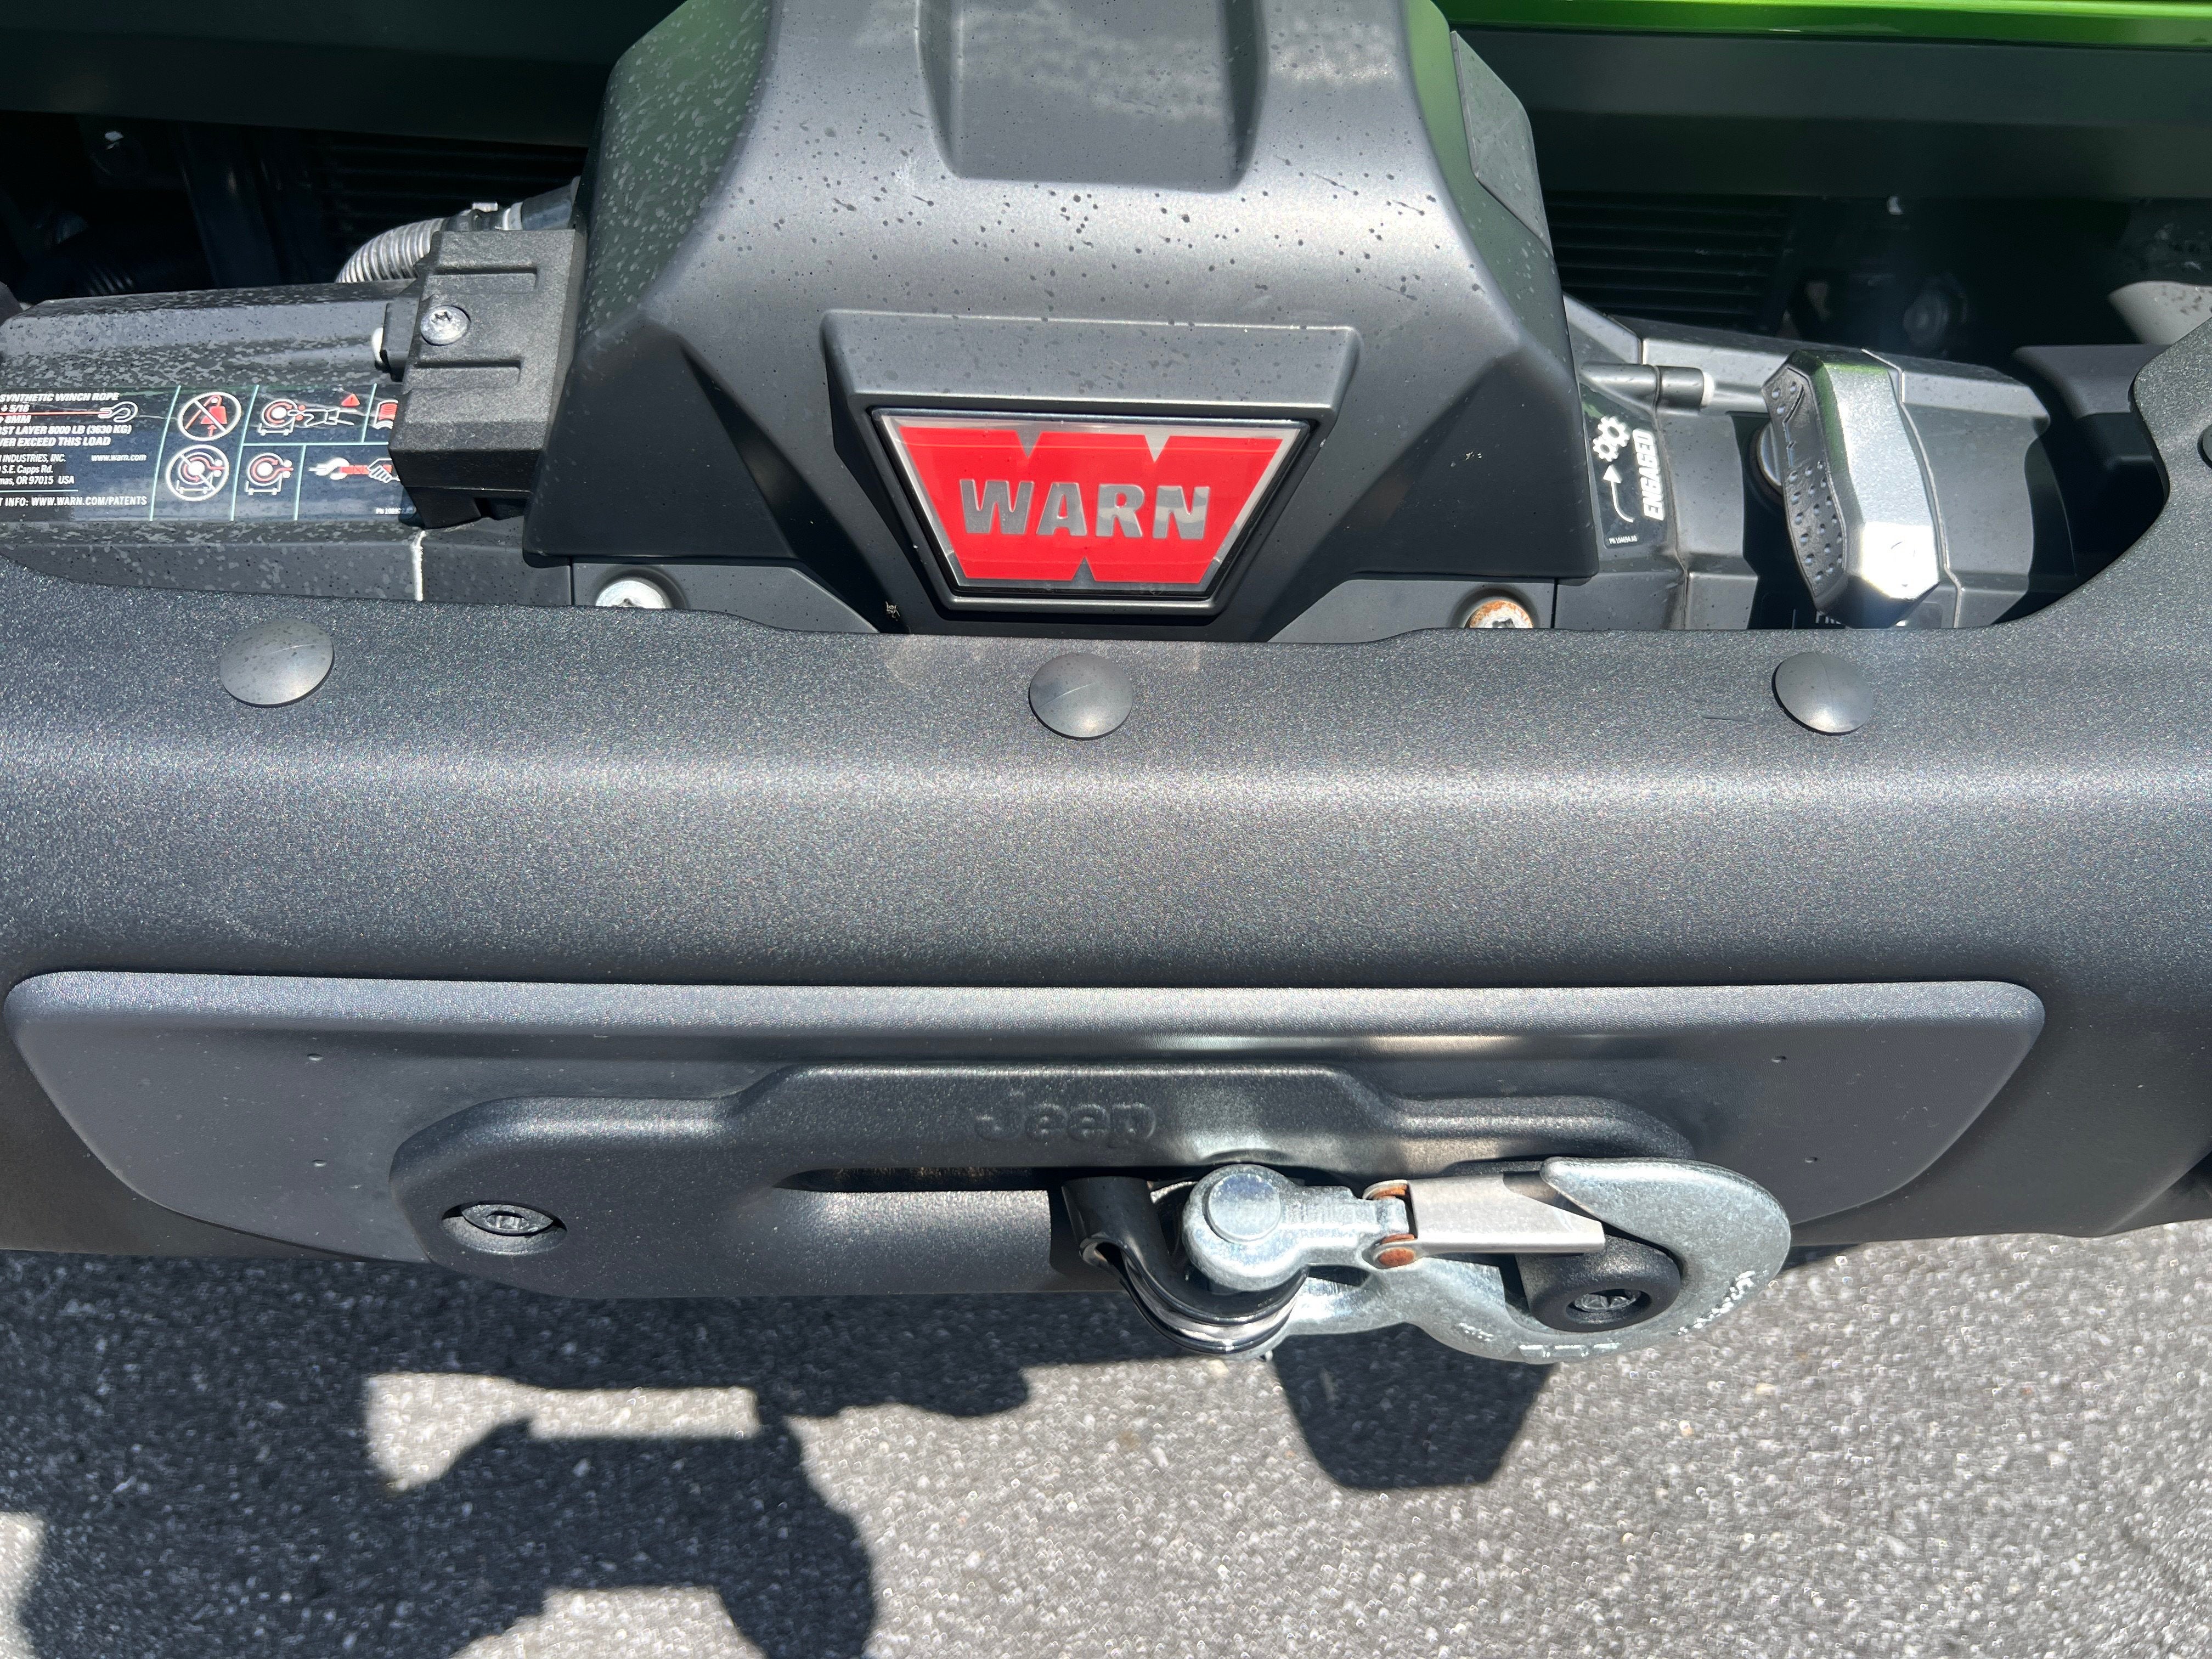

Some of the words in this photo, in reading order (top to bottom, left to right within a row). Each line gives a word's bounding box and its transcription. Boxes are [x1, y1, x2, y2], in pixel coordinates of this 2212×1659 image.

[0, 393, 54, 402] SYNTHETIC
[55, 393, 92, 402] WINCH
[92, 392, 120, 401] ROPE
[9, 404, 30, 413] 5/16
[4, 415, 32, 424] 8MM
[15, 425, 48, 435] LAYER
[48, 425, 71, 435] 8000
[71, 425, 86, 435] LB
[86, 424, 113, 435] (3630
[112, 424, 132, 435] KG)
[17, 437, 57, 447] EXCEED
[57, 437, 82, 446] THIS
[82, 436, 112, 446] LOAD
[2, 454, 49, 463] INDUSTRIES,
[50, 453, 66, 462] INC.
[2, 465, 16, 474] S.E.
[16, 465, 40, 475] Capps
[41, 464, 54, 473] Rd.
[1632, 428, 1665, 521] ENGAGED
[16, 476, 29, 485] OR
[29, 475, 54, 485] 97015
[58, 475, 75, 485] USA
[5, 497, 29, 506] INFO:
[31, 495, 148, 506] WWW.WARN.COM/PATENTS
[959, 478, 1210, 540] WARN
